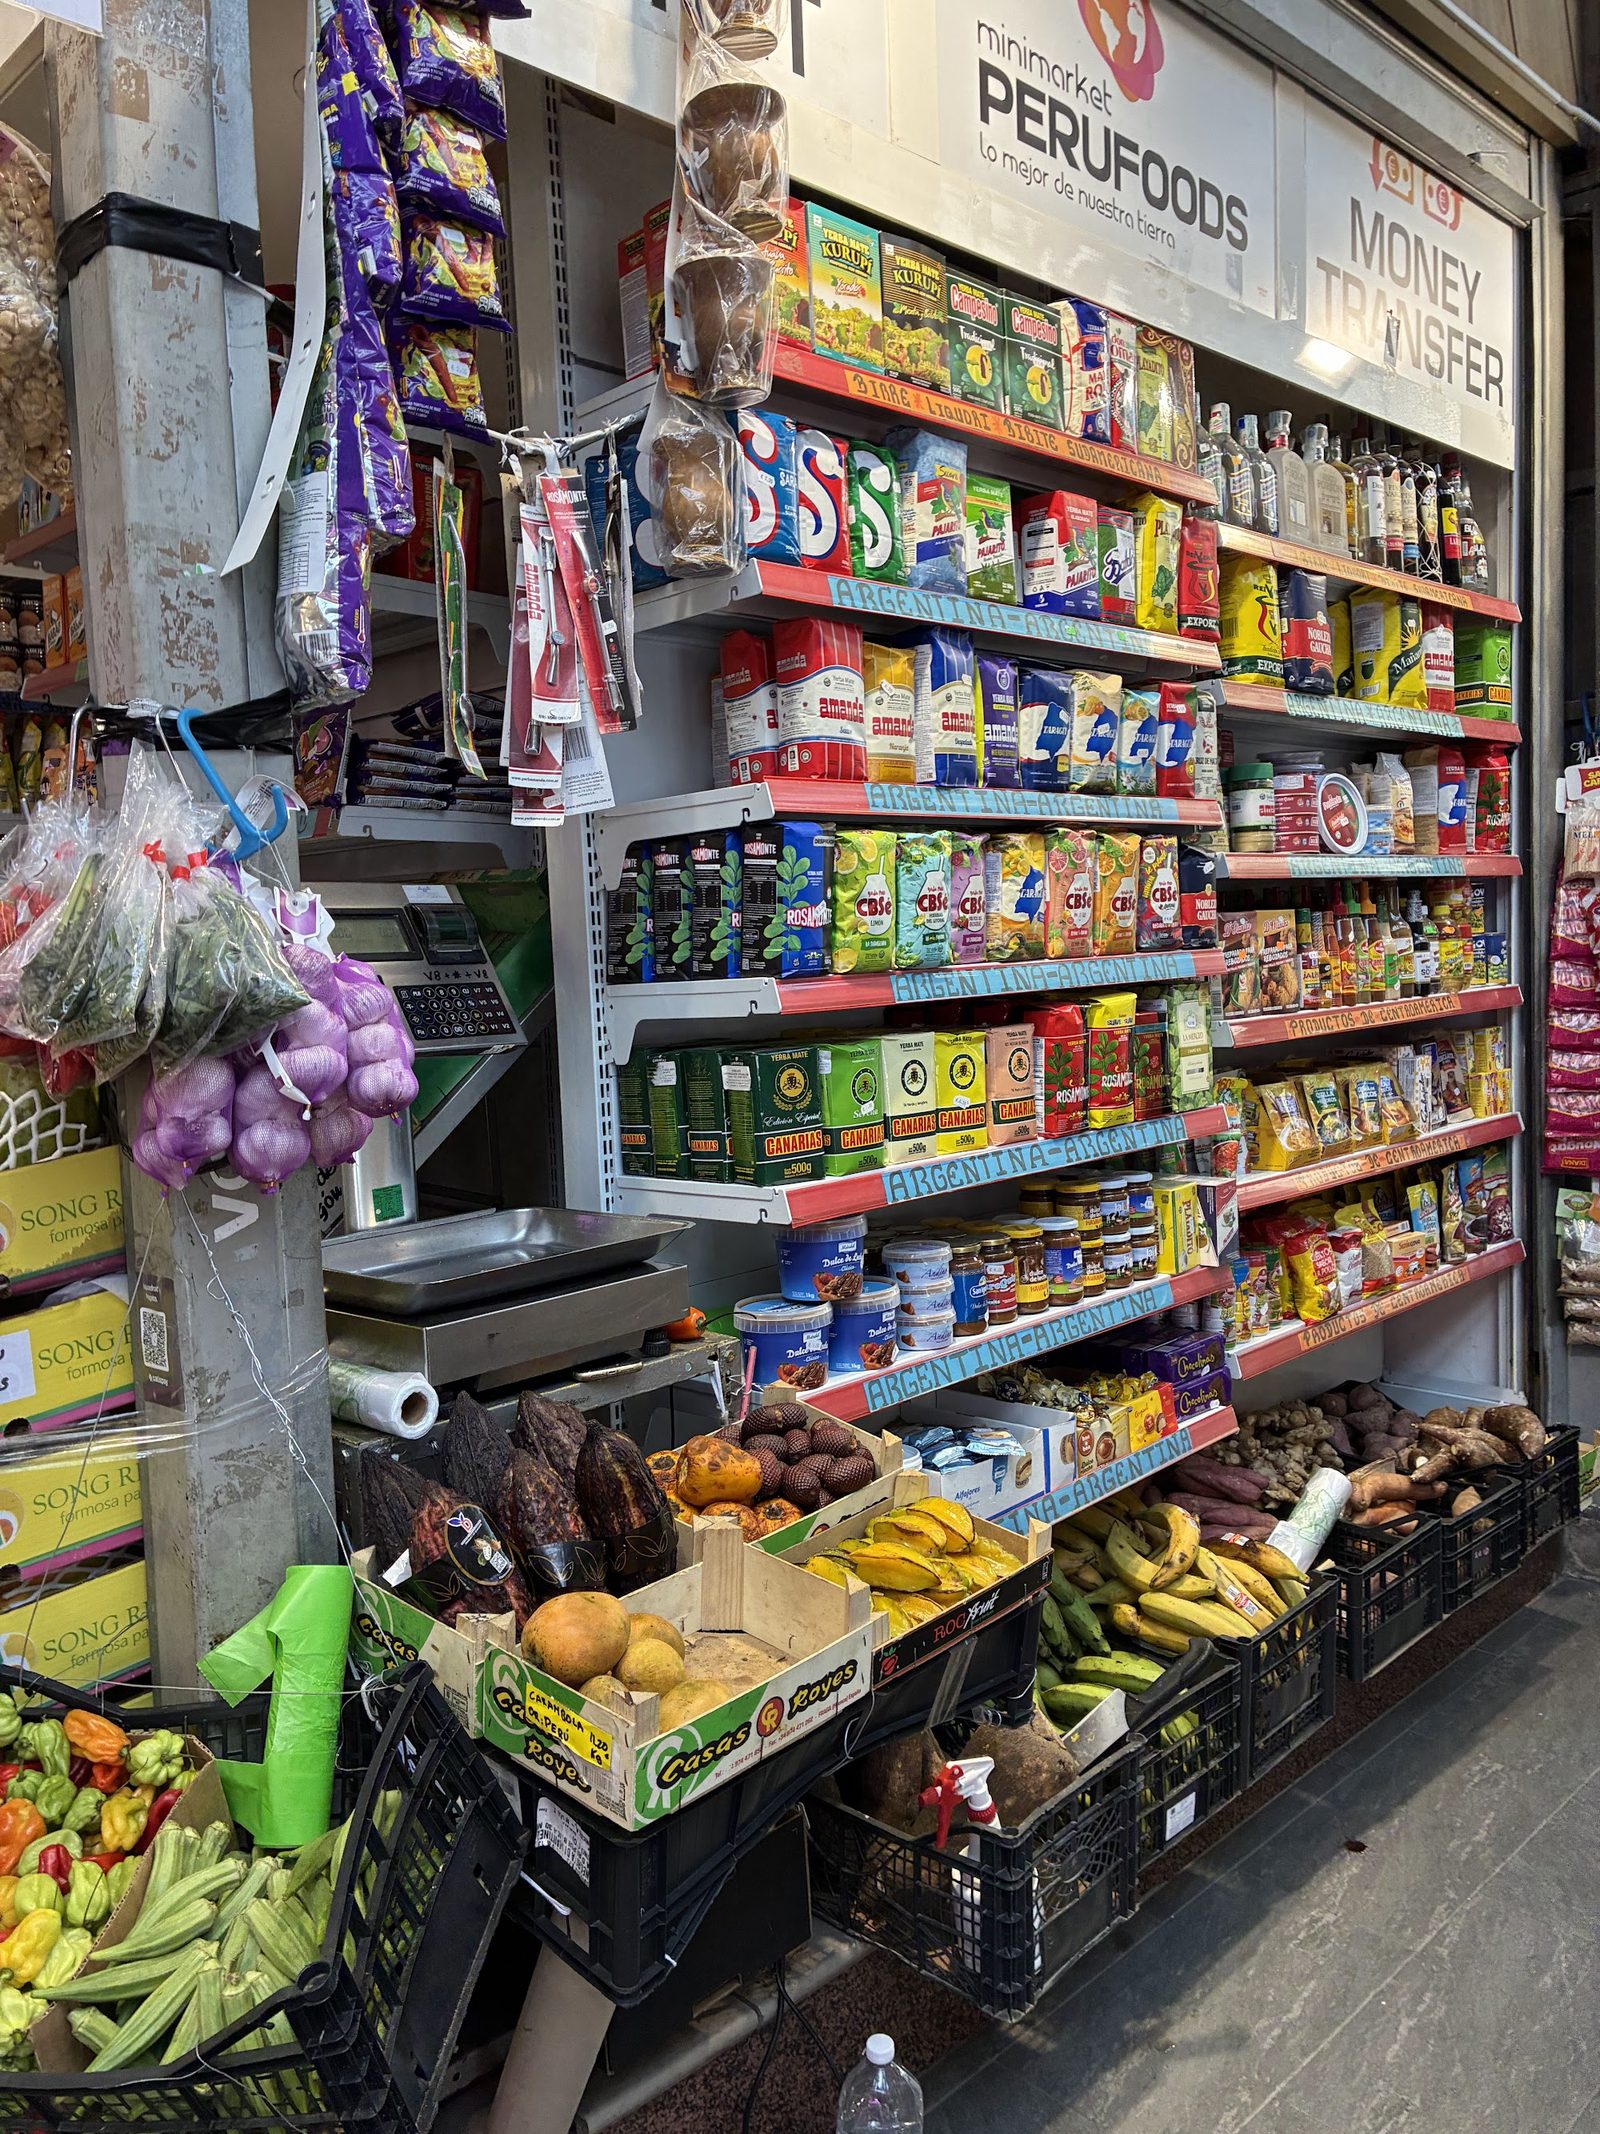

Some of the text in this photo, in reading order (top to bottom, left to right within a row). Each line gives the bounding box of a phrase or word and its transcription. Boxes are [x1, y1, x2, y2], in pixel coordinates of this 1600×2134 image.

[976, 18, 1113, 117] minimarket
[979, 58, 1249, 254] PERUFOODS
[1002, 150, 1049, 191] mejor
[1054, 171, 1075, 201] de
[1079, 189, 1135, 231] nuestra
[1136, 210, 1176, 250] tierra
[823, 227, 870, 257] YERBA MATE
[820, 241, 873, 275] KURUPÍ
[895, 254, 940, 280] YERBA MATE
[1350, 197, 1482, 327] MONEY
[893, 268, 942, 300] KURUPÍ
[950, 284, 998, 327] Campesino
[958, 325, 996, 352] Tradicional
[1011, 306, 1058, 346] Campesino
[1317, 256, 1504, 409] TRANSFER
[1019, 346, 1056, 371] Tradicional
[1066, 440, 1163, 484] SUDAMERICANA
[546, 490, 588, 504] ROSAMONTE
[977, 541, 1005, 560] PAJARITO
[524, 562, 542, 621] amanda
[1066, 568, 1097, 590] PAJARITO
[1187, 616, 1217, 629] EXPORT
[1257, 659, 1284, 674] EXPORT
[819, 696, 864, 724] amanda
[941, 709, 975, 733] aman
[1043, 726, 1068, 737] TARAG
[1134, 733, 1156, 745] TARAG
[1170, 739, 1191, 750] TARAG
[870, 780, 1163, 819] ARGENTINA-ARGENTINA
[745, 843, 776, 856] ROSAMONTE
[856, 897, 892, 918] CBSé
[917, 893, 948, 913] CBSé
[1065, 893, 1092, 911] CBSé
[1112, 894, 1136, 912] CBSé
[1152, 887, 1177, 903] CBSé
[1195, 900, 1216, 911] NOBLE
[893, 953, 1179, 1001] ARGENTINA-ARGENTINA
[1289, 997, 1455, 1038] PRODUCTOS DE CENTROAMERICA
[771, 1050, 809, 1062] YERBA MATE
[1056, 1085, 1089, 1104] ROSAM
[763, 1114, 793, 1127] Edición
[938, 1106, 985, 1130] CANARIAS
[1000, 1100, 1035, 1118] CANARIA
[841, 1124, 885, 1149] CANARIAS
[893, 1112, 936, 1138] CANARIAS
[1017, 1125, 1030, 1136] 500g
[622, 1134, 647, 1145] CANARIAS
[690, 1139, 719, 1151] CANARIAS
[765, 1130, 823, 1157] CANARIAS
[912, 1142, 927, 1154] 500g
[960, 1134, 975, 1146] 500g
[1384, 1137, 1461, 1166] CENTROAMERICA
[791, 1162, 812, 1175] 500g
[862, 1155, 878, 1166] 500g
[889, 1114, 1187, 1203] ARGENTINA-ARGENTINA
[20, 1195, 97, 1232] SONG
[49, 1216, 110, 1244] formosa
[822, 1254, 852, 1269] Dulce de
[1302, 1268, 1466, 1349] PRODUCTOS DE CENTROAMERICA
[868, 1326, 885, 1339] Dulce
[38, 1330, 115, 1371] SONG
[787, 1348, 808, 1359] Dulce
[867, 1286, 1157, 1412] ARGENTINA-ARGENTINA
[66, 1352, 125, 1382] formosa
[1177, 1353, 1215, 1378] Chocolinas
[1179, 1388, 1218, 1413] Chocolinas
[32, 1473, 110, 1516] SONG
[955, 1485, 981, 1502] Alfajores
[60, 1496, 119, 1526] formosa
[43, 1615, 120, 1661] SONG
[933, 1615, 966, 1643] ROC
[70, 1638, 129, 1669] formosa
[529, 1690, 584, 1732] CARAMBOLA
[661, 1723, 751, 1786] Casas
[790, 1663, 855, 1715] Royes
